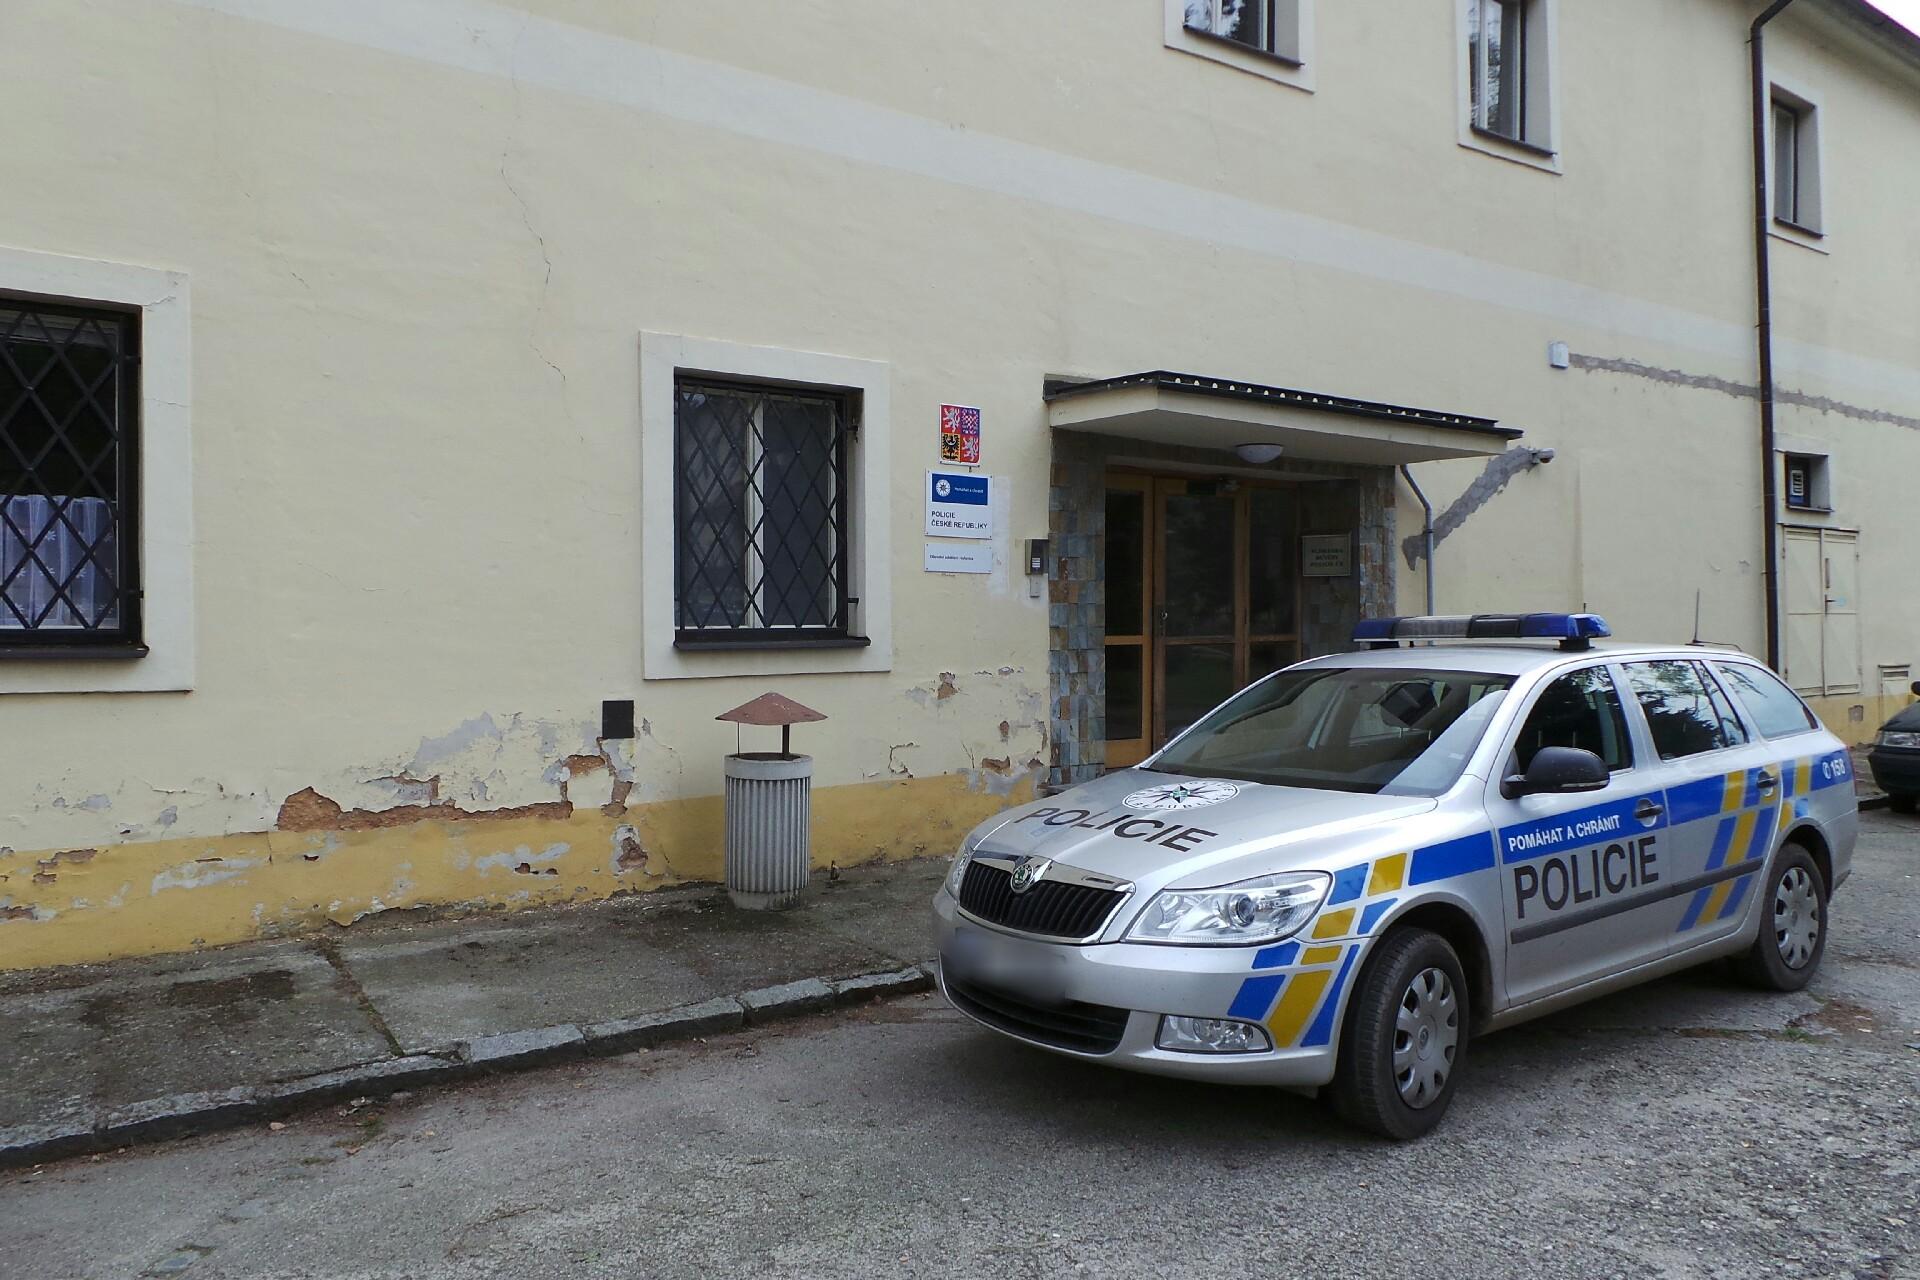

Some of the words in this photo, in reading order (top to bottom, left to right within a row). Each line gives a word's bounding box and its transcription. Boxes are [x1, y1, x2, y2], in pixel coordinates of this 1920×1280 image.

[1830, 758, 1846, 777] 158
[1014, 807, 1219, 853] POLICIE
[1508, 828, 1563, 852] POMÁHAT
[1567, 825, 1575, 841] A
[1576, 814, 1621, 838] CHRÁNIT
[1513, 835, 1659, 919] POLICIE
